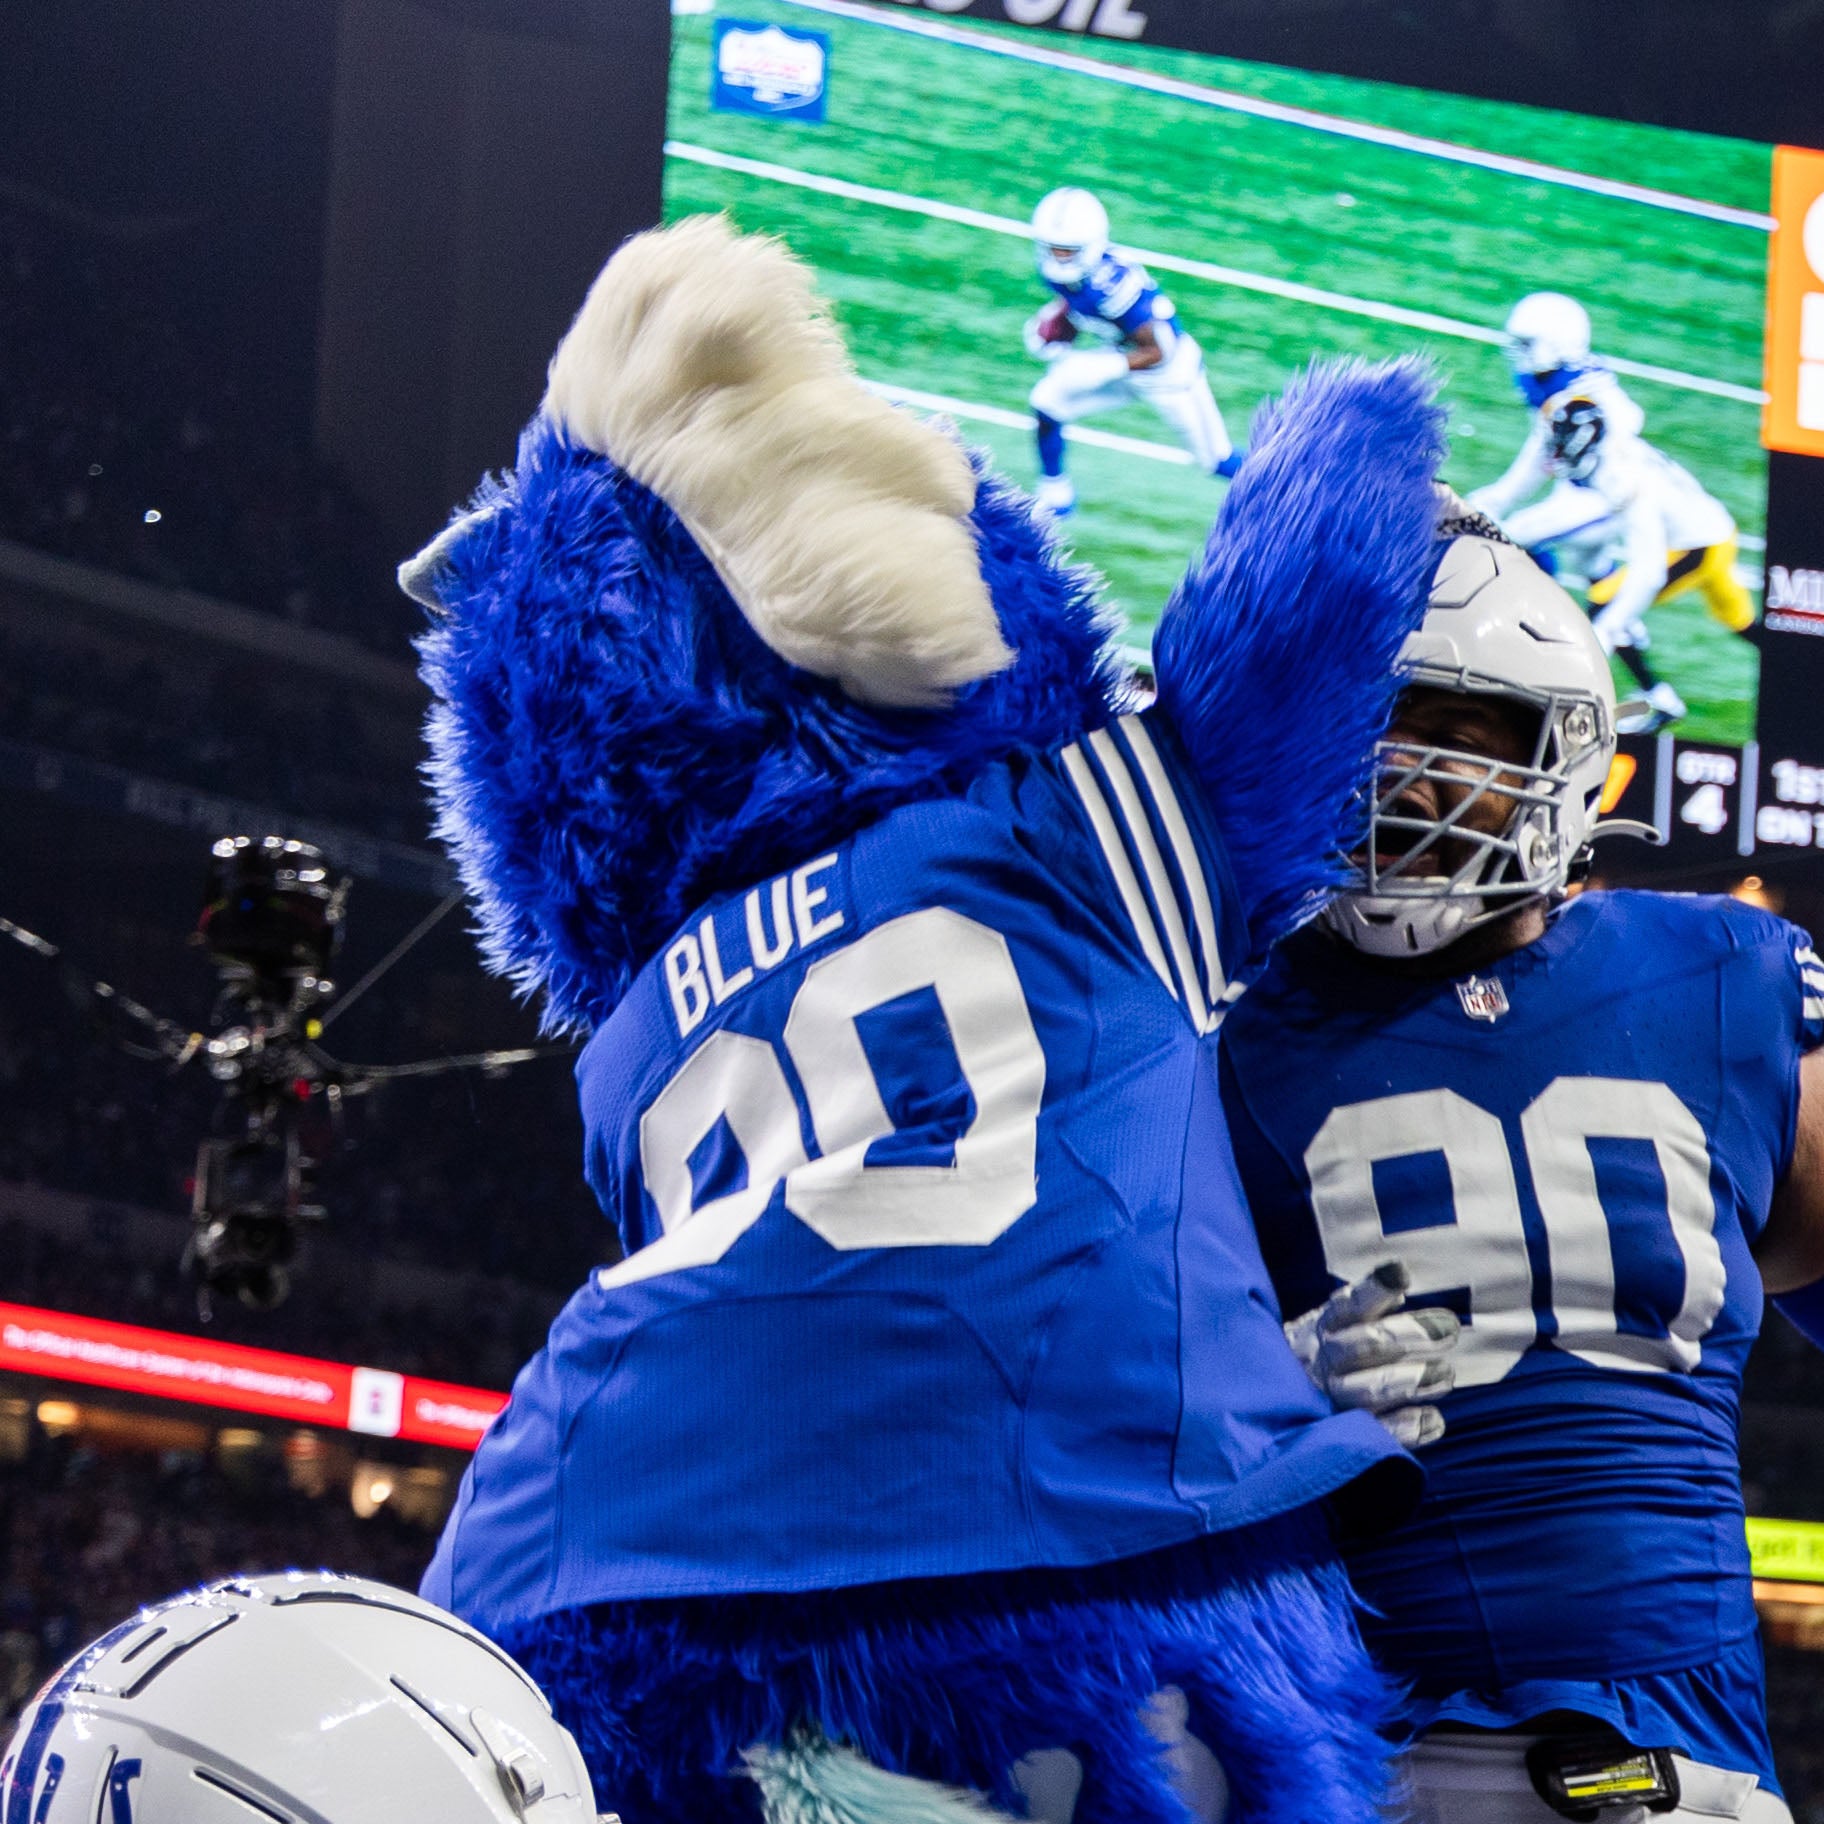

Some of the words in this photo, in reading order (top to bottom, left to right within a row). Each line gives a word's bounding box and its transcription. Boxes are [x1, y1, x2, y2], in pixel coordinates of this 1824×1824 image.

[1679, 783, 1729, 835] 4
[664, 851, 848, 1040] BLUE
[1303, 1075, 1725, 1389] 90
